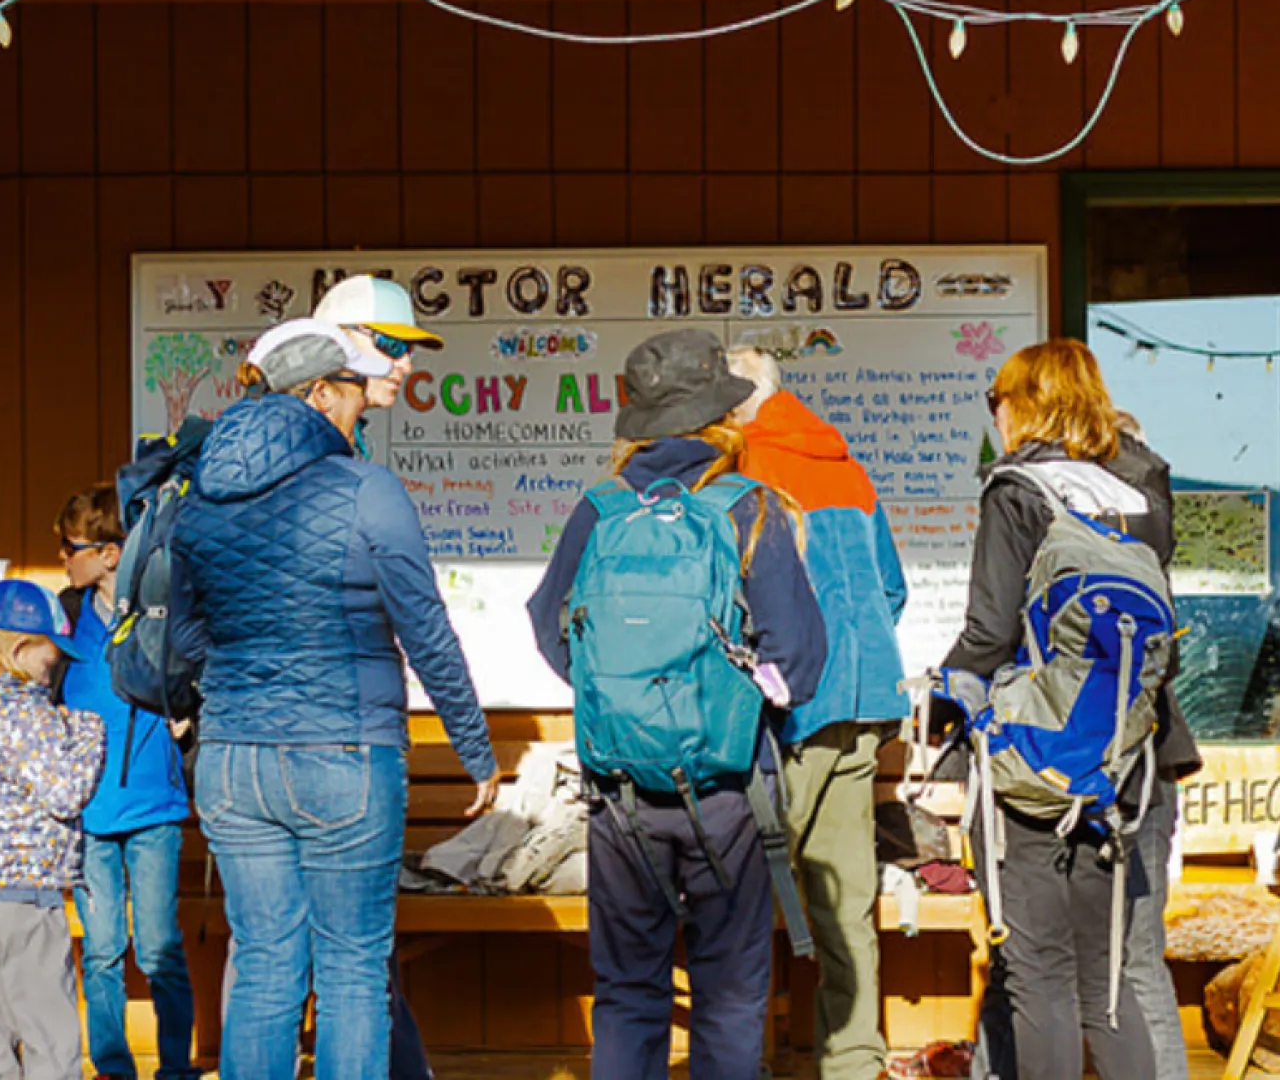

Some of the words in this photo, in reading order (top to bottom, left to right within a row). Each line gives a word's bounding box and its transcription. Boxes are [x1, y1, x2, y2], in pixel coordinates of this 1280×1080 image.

[310, 266, 591, 318] HCTOR
[649, 258, 921, 317] HERALD
[405, 372, 528, 416] CCHY
[443, 421, 593, 443] HOMECOMING
[393, 451, 455, 473] What
[514, 473, 584, 494] Archery
